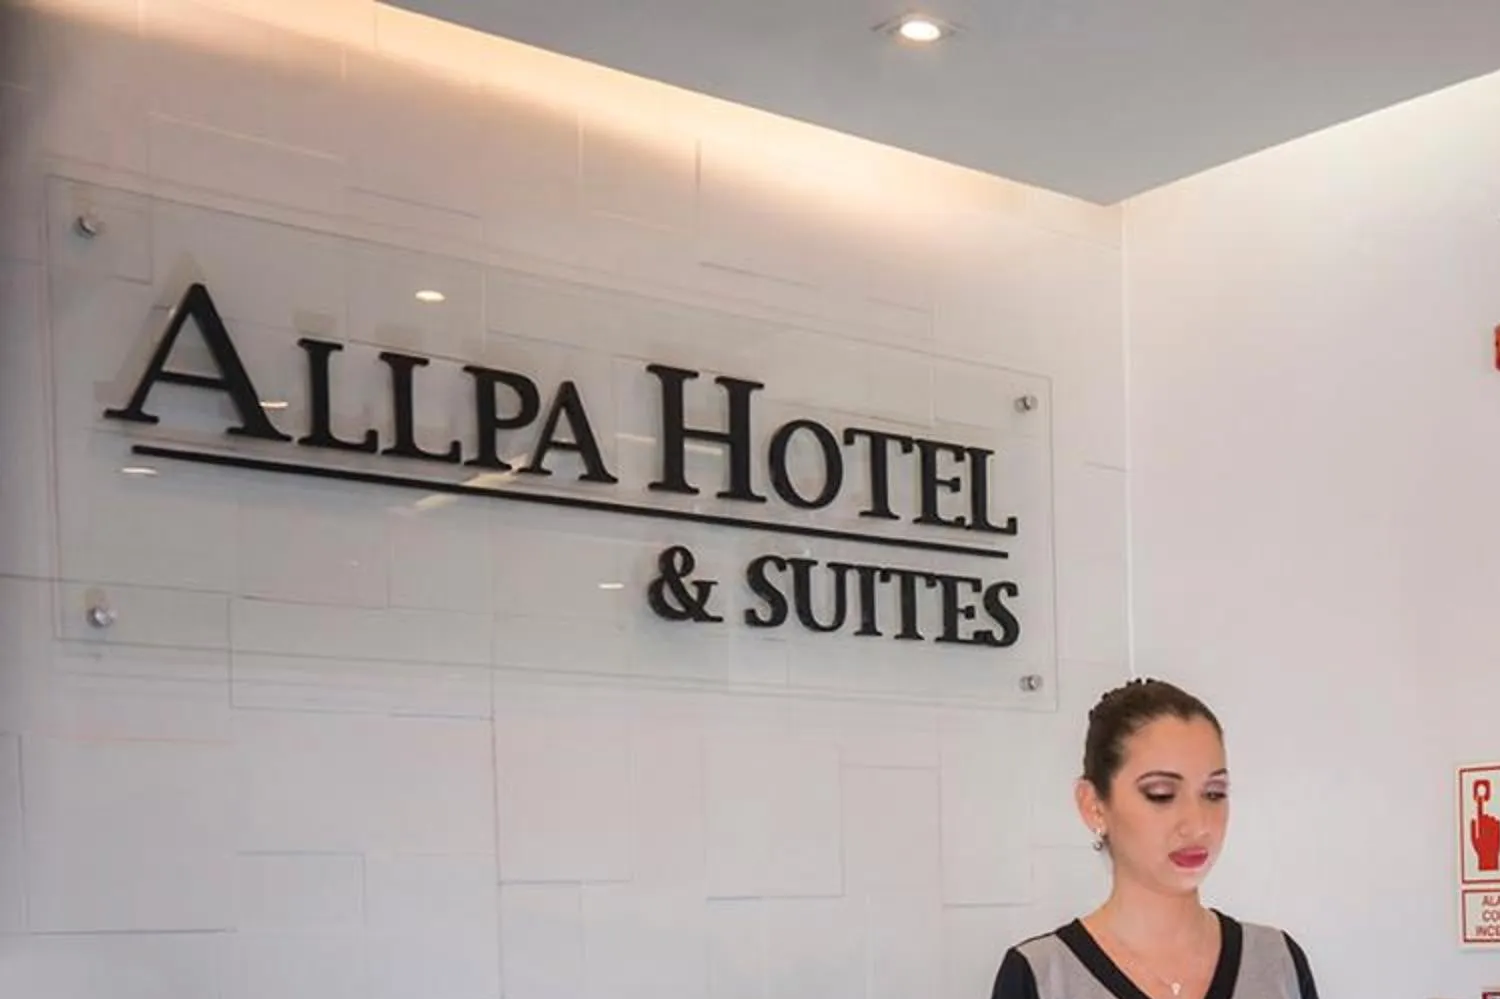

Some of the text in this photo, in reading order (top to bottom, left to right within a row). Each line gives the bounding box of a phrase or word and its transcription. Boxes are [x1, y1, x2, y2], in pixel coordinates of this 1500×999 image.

[103, 282, 1018, 535] ALLPA HOTEL
[647, 545, 1020, 647] & SUITES
